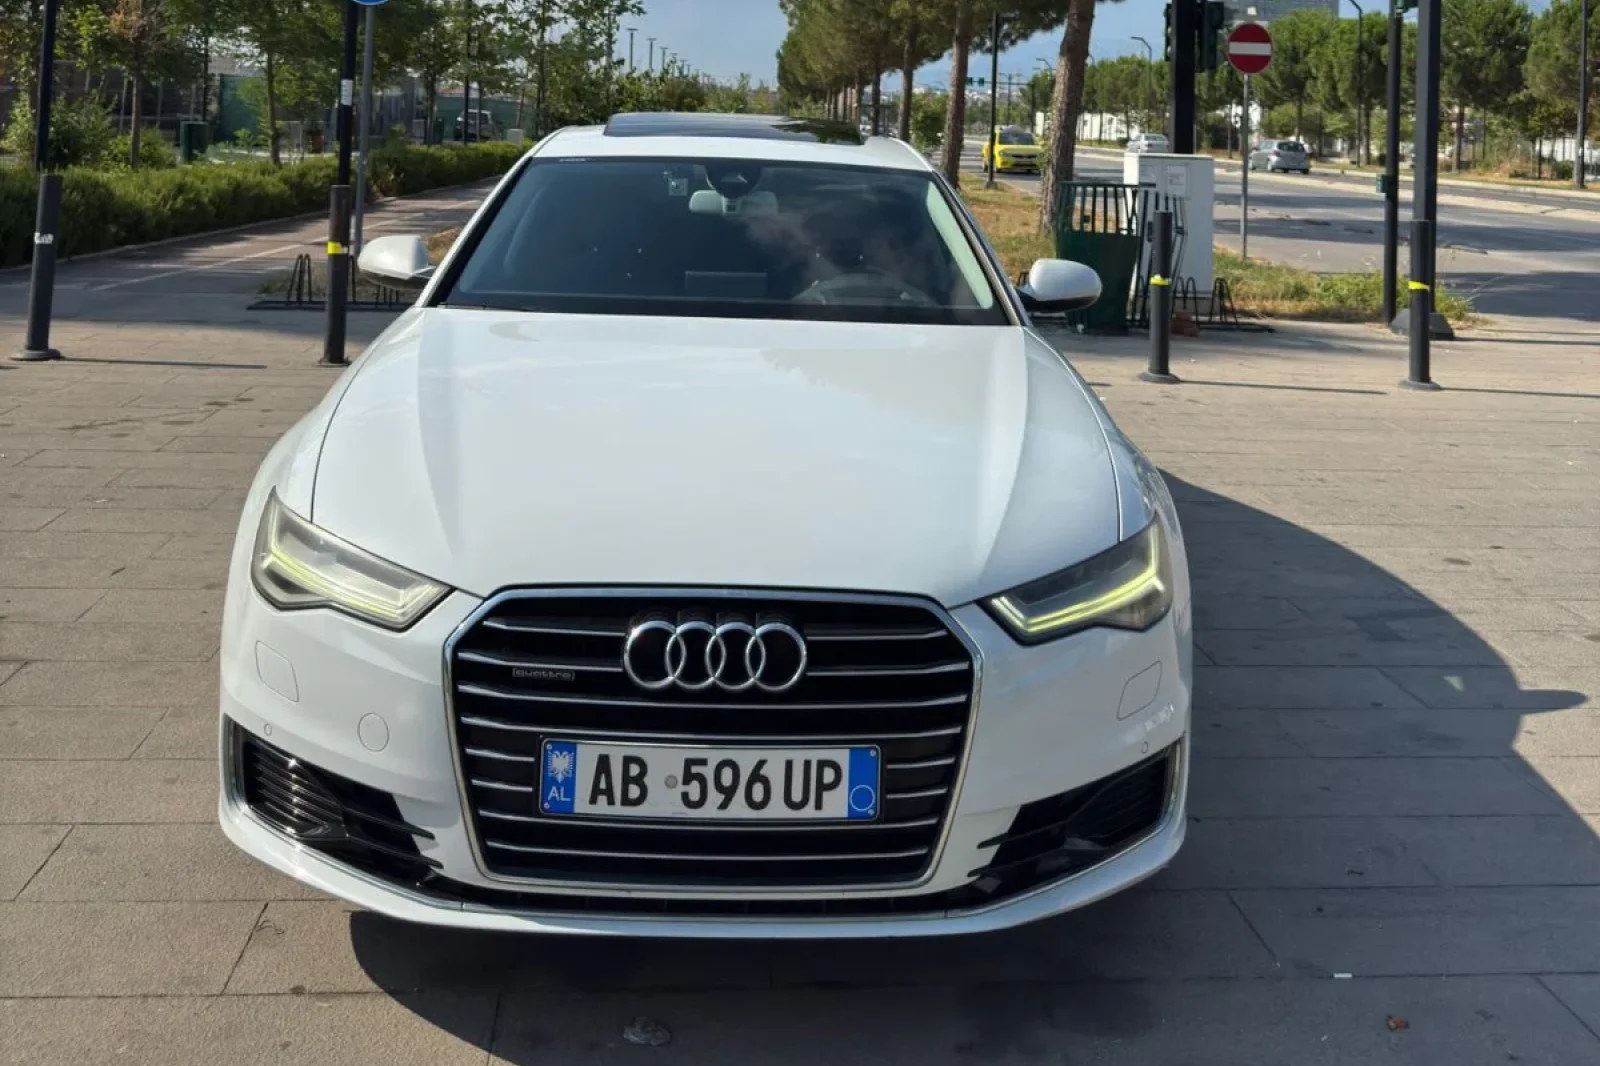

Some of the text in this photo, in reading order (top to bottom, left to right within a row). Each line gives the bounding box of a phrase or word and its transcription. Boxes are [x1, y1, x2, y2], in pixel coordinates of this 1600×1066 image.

[514, 668, 573, 679] quattro
[588, 753, 843, 811] AB 596 UP
[547, 785, 571, 802] AL
